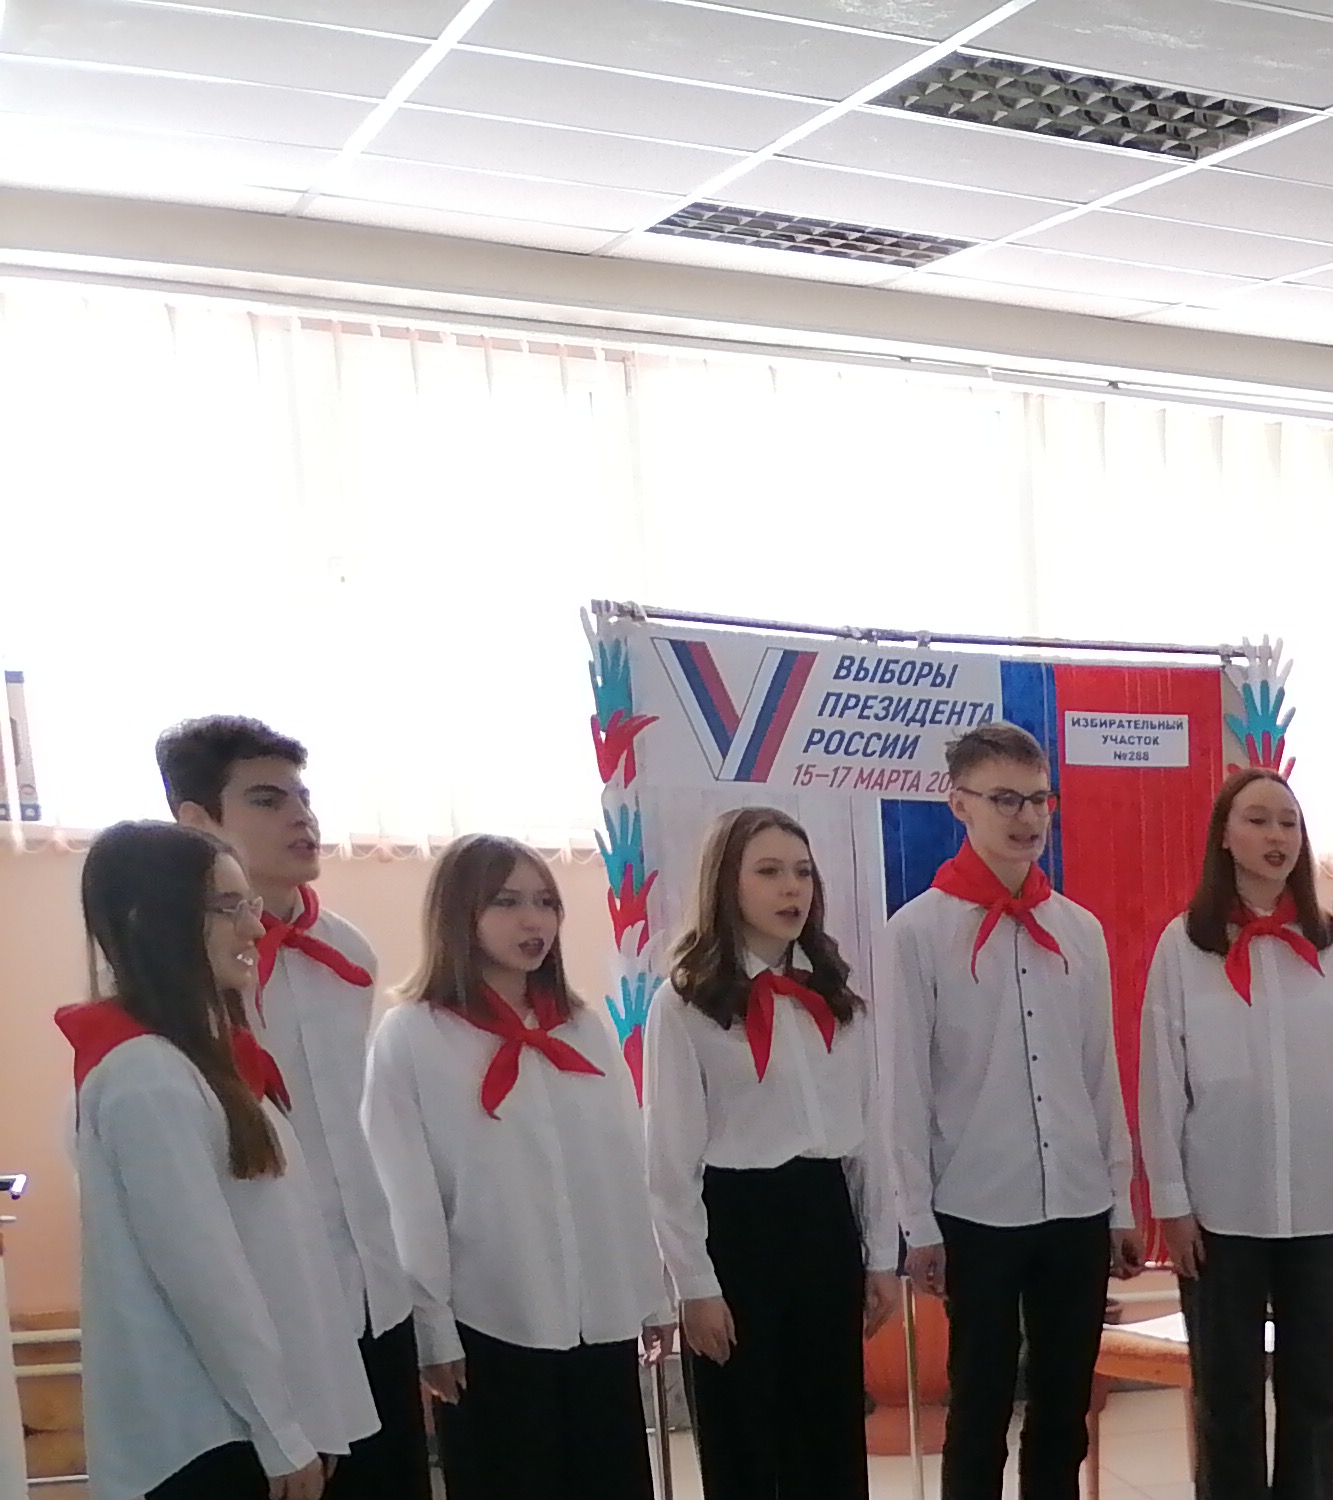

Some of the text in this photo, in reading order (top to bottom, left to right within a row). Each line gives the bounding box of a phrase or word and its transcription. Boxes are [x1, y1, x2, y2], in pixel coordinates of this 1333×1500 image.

[833, 654, 959, 689] ВЫБОРЫ
[817, 691, 995, 728] ПРЕЗИДЕНТА
[1071, 717, 1184, 731] ИЗБИРАТЕЛЬНЫЙ
[802, 728, 921, 760] РОССИИ
[1101, 734, 1160, 746] УЧАСТОК
[853, 766, 922, 793] МАРТА
[925, 770, 951, 794] 20
